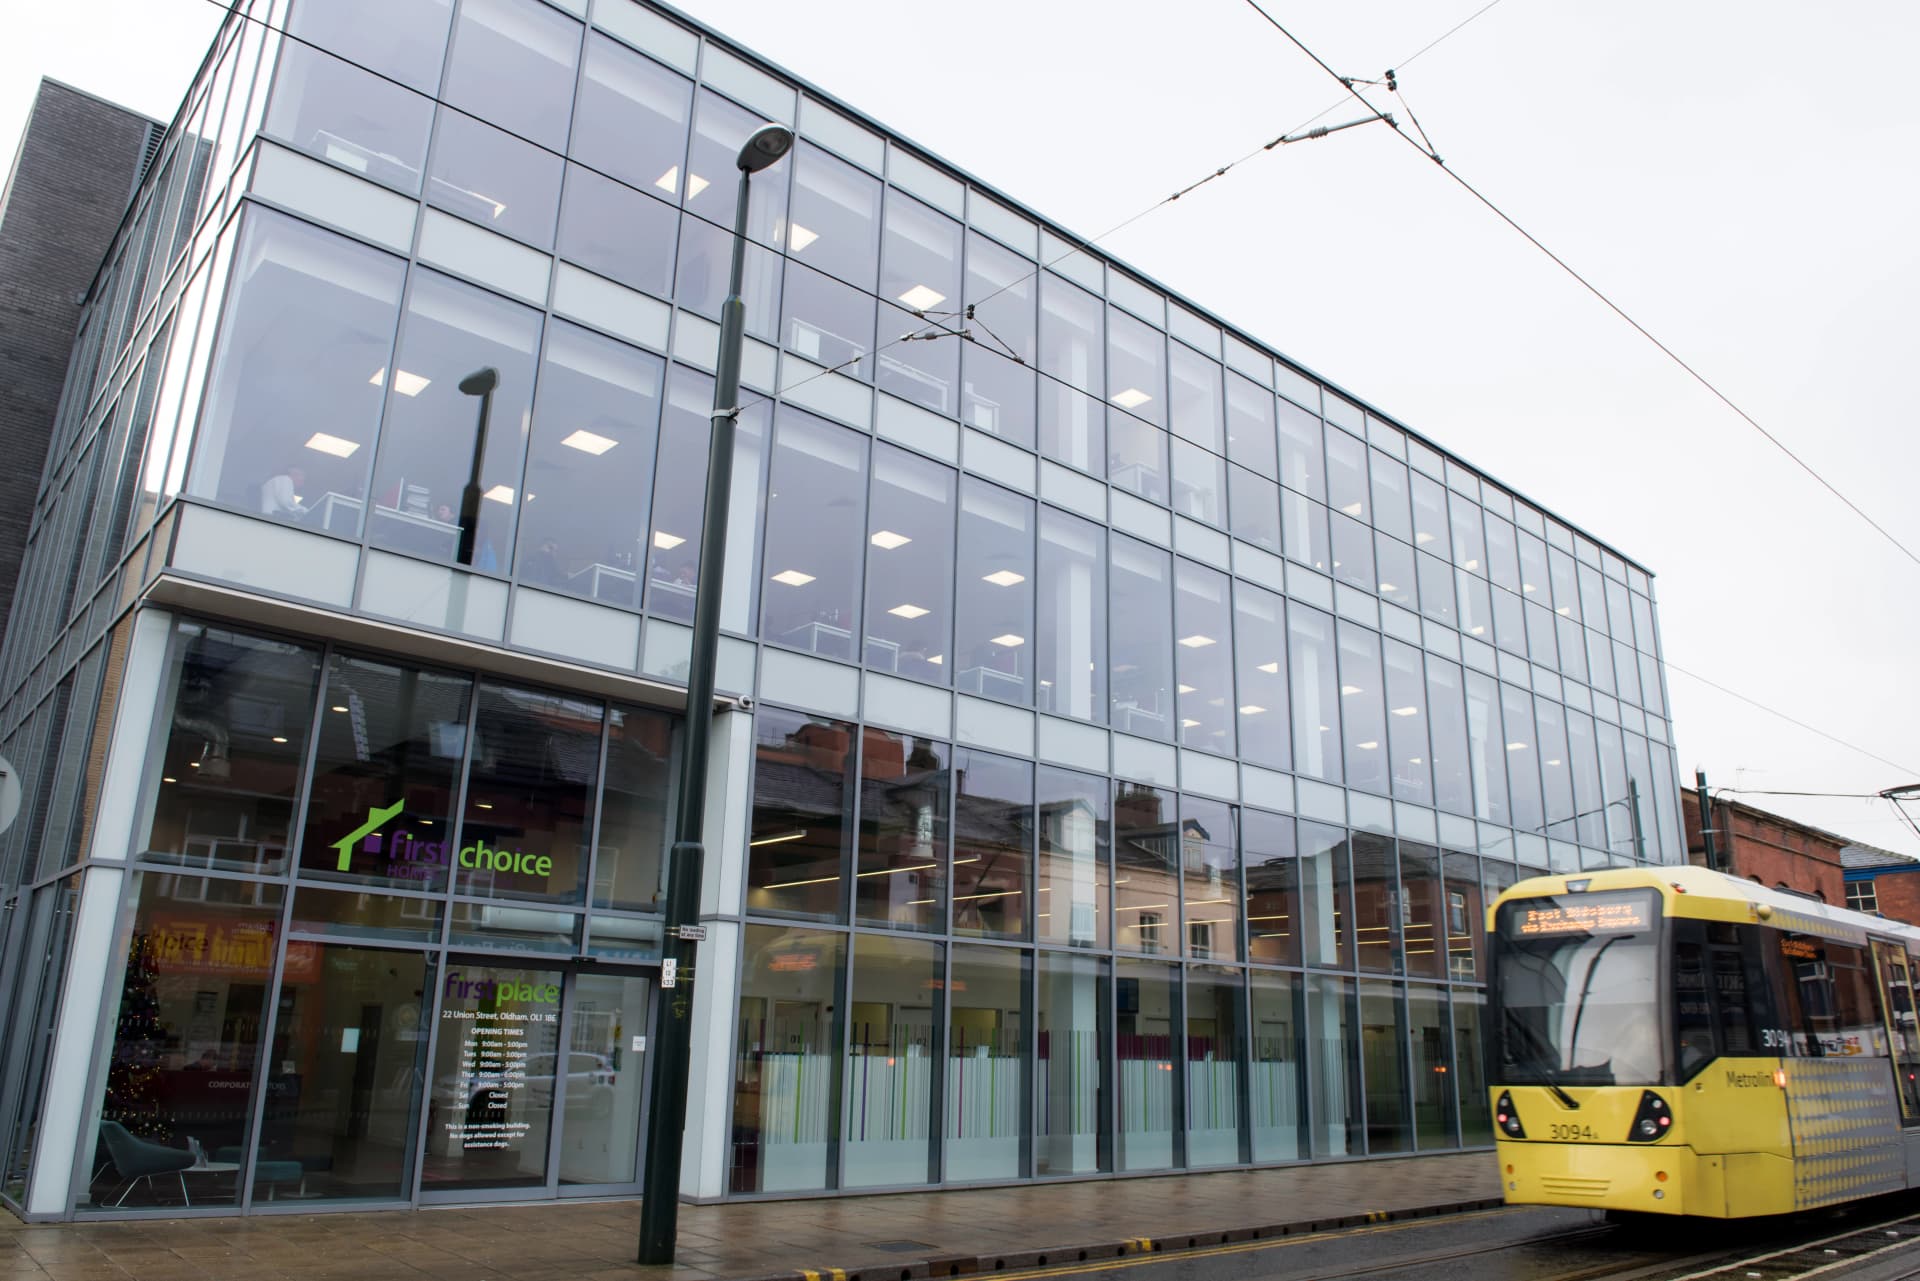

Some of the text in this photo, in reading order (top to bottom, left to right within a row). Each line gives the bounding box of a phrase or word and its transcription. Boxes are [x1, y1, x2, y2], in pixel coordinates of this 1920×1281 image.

[389, 829, 553, 877] first choice
[442, 1010, 451, 1018] 22
[453, 1010, 475, 1019] Union
[471, 1027, 524, 1036] OPENING TIMES
[488, 1091, 509, 1099] Closed
[487, 1101, 508, 1109] Closed
[1550, 1123, 1592, 1140] 3094
